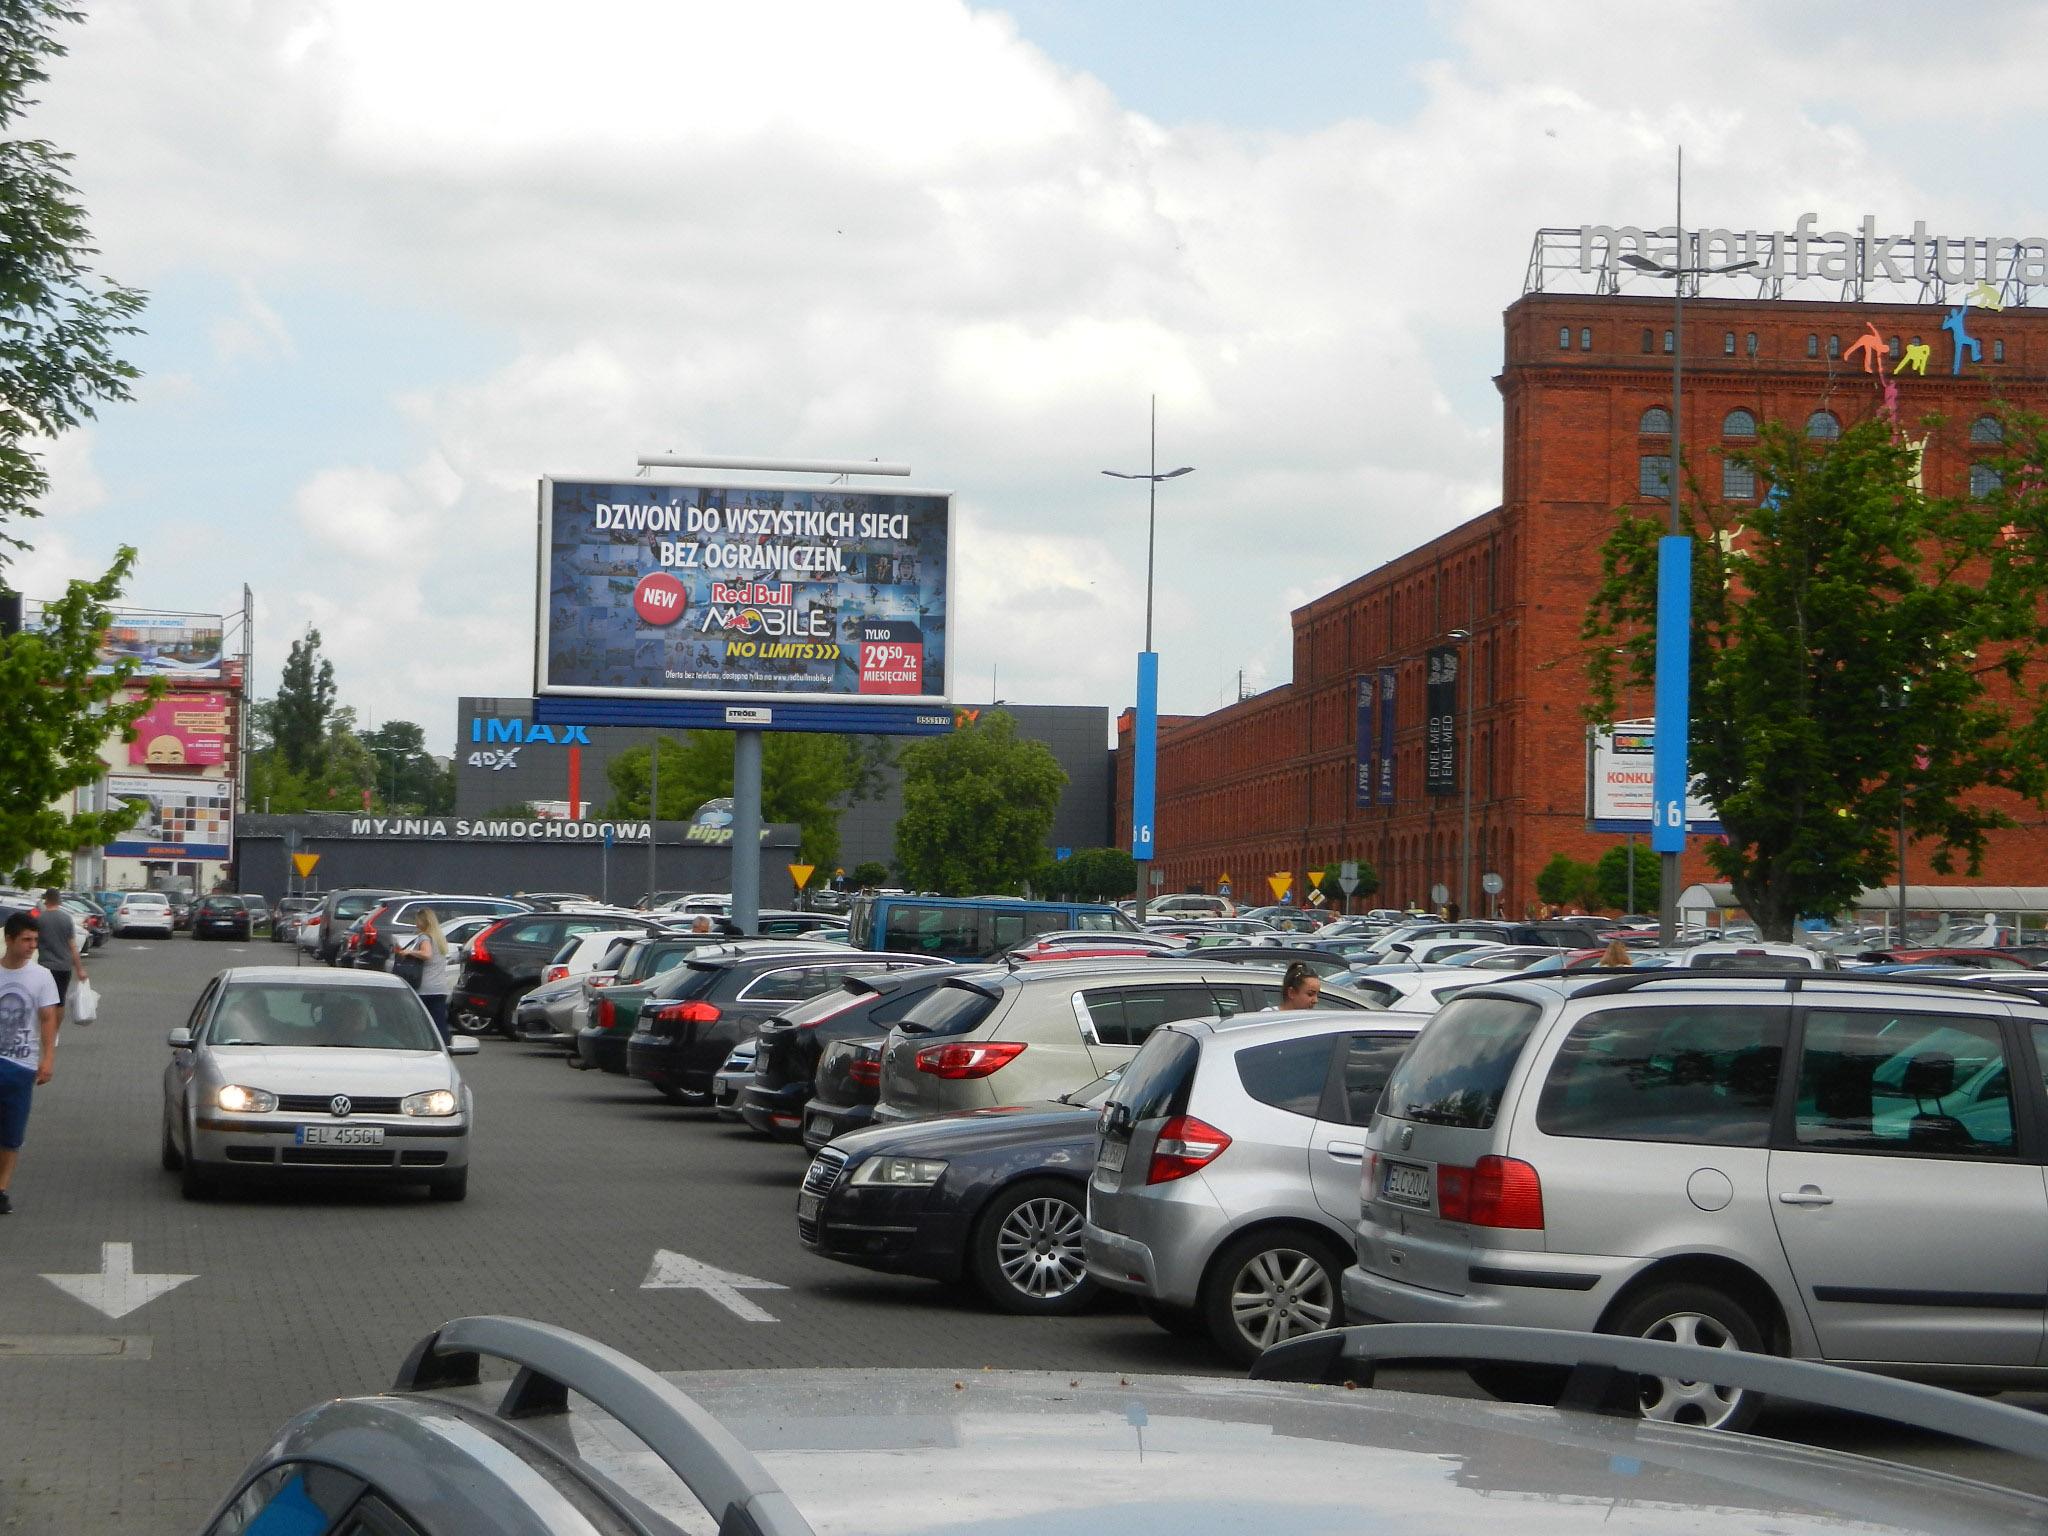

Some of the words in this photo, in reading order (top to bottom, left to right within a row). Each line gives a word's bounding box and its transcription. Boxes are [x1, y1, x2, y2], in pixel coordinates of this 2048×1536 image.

[1580, 212, 2048, 287] manufaktura
[596, 498, 681, 532] DZWOŃ
[687, 506, 720, 533] DO
[725, 508, 855, 538] WSZYSTKICH
[860, 512, 909, 540] SIECI
[660, 541, 700, 567] BEZ
[704, 540, 847, 572] OGRANICZEŃ.
[643, 587, 678, 609] NEW
[711, 582, 751, 605] Red
[753, 583, 793, 606] Bull
[701, 606, 831, 637] MOBILE
[864, 628, 891, 640] TYLKO
[727, 641, 756, 658] NO
[759, 642, 815, 660] LIMITS
[903, 655, 917, 669] ZŁ
[863, 670, 918, 685] MIESIĘCZNIE
[471, 717, 592, 744] IMAX
[467, 746, 522, 771] 4DX
[1359, 763, 1370, 791] JYSK
[1667, 800, 1681, 827] 6
[351, 818, 448, 836] MYJNIA
[456, 820, 652, 840] SAMOCHODOWA
[1141, 825, 1151, 843] 6
[305, 1127, 328, 1143] EL
